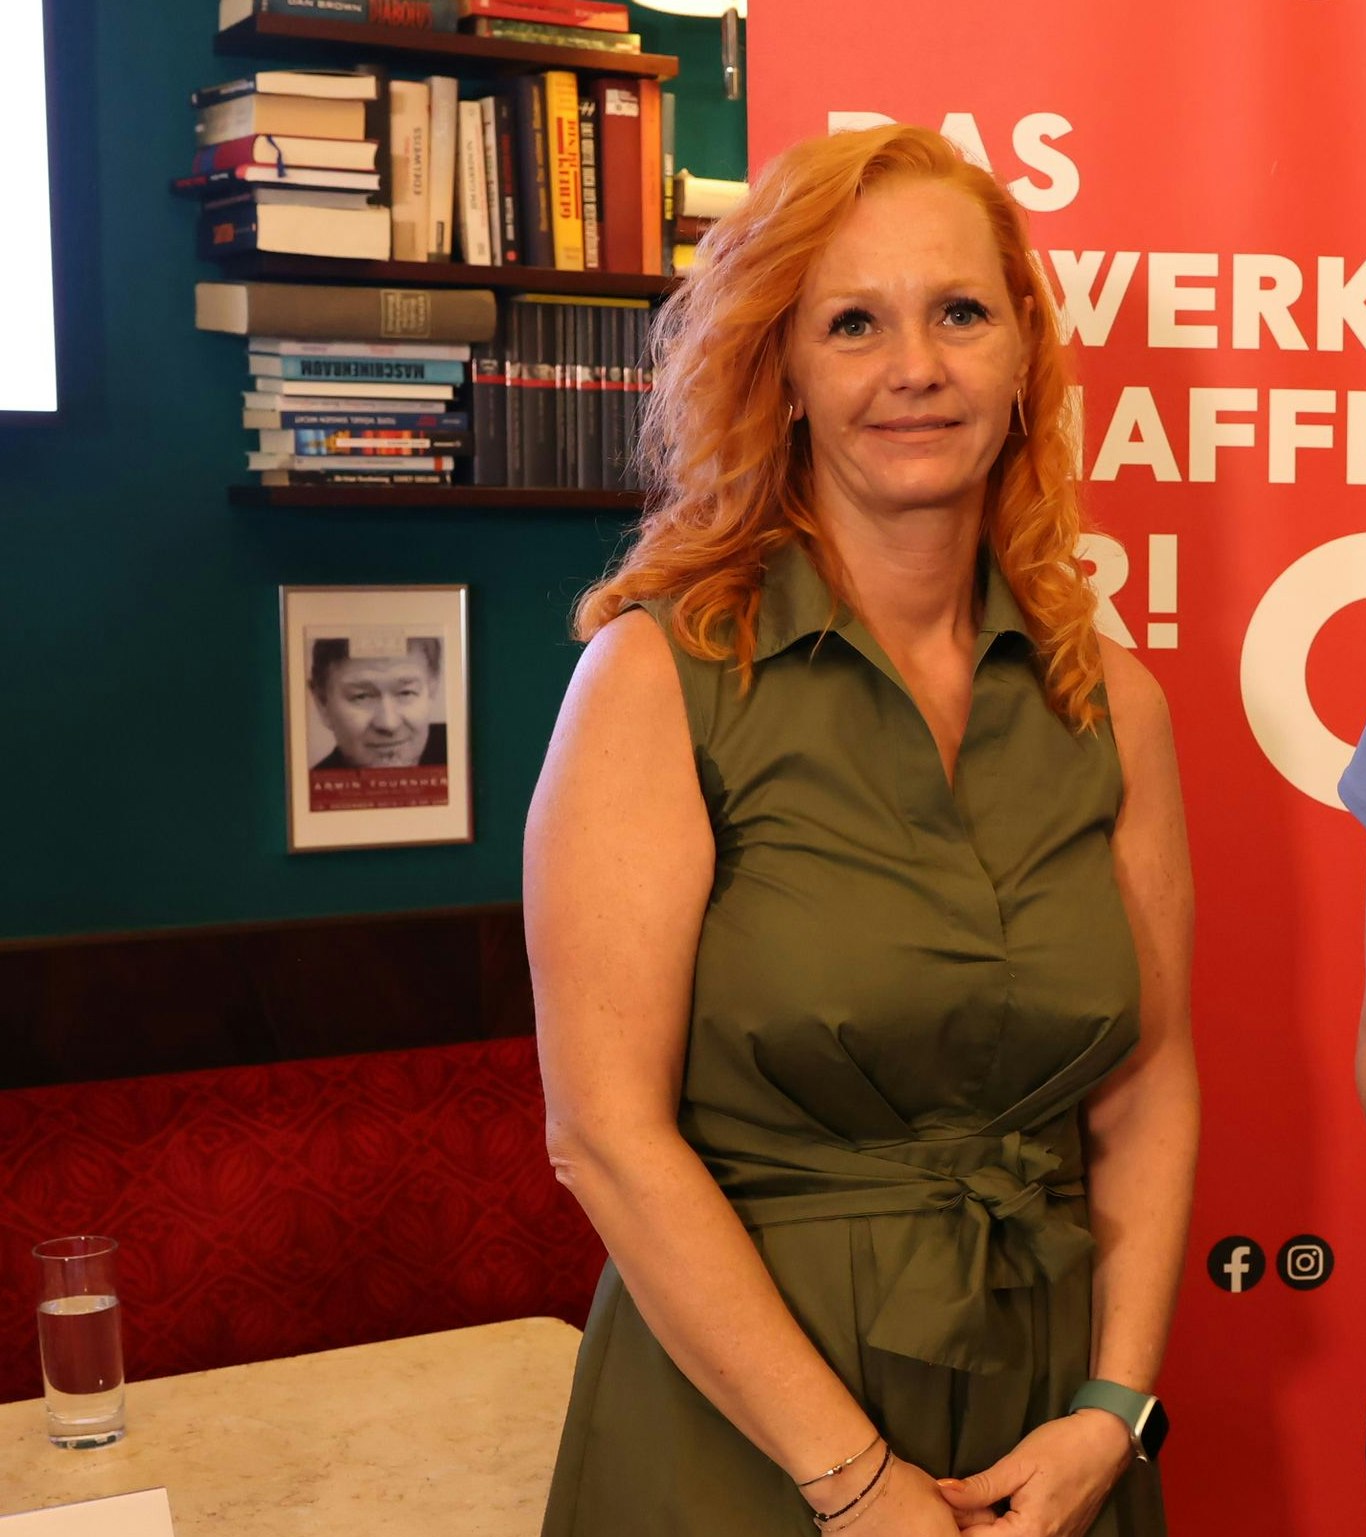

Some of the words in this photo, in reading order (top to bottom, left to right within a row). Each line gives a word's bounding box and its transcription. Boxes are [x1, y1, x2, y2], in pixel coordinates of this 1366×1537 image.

[828, 111, 1080, 213] AS
[301, 360, 425, 379] MASCHINENRAUM
[1072, 534, 1178, 650] R!
